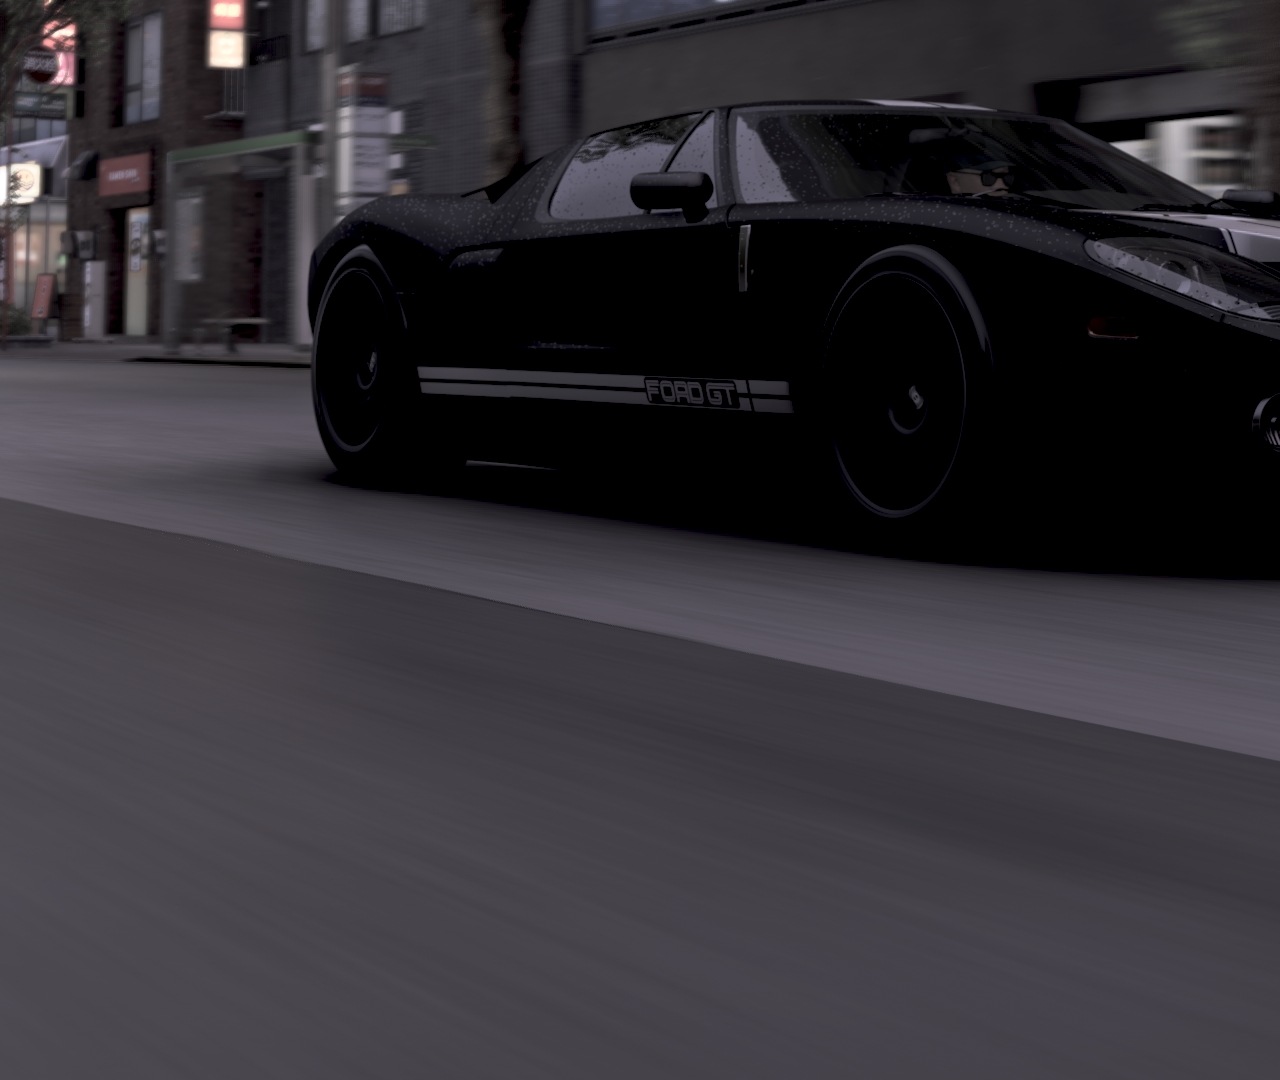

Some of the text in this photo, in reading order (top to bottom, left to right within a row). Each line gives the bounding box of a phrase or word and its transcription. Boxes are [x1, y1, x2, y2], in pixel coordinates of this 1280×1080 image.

[24, 56, 56, 72] 消火栓
[645, 379, 735, 406] FORD GT
